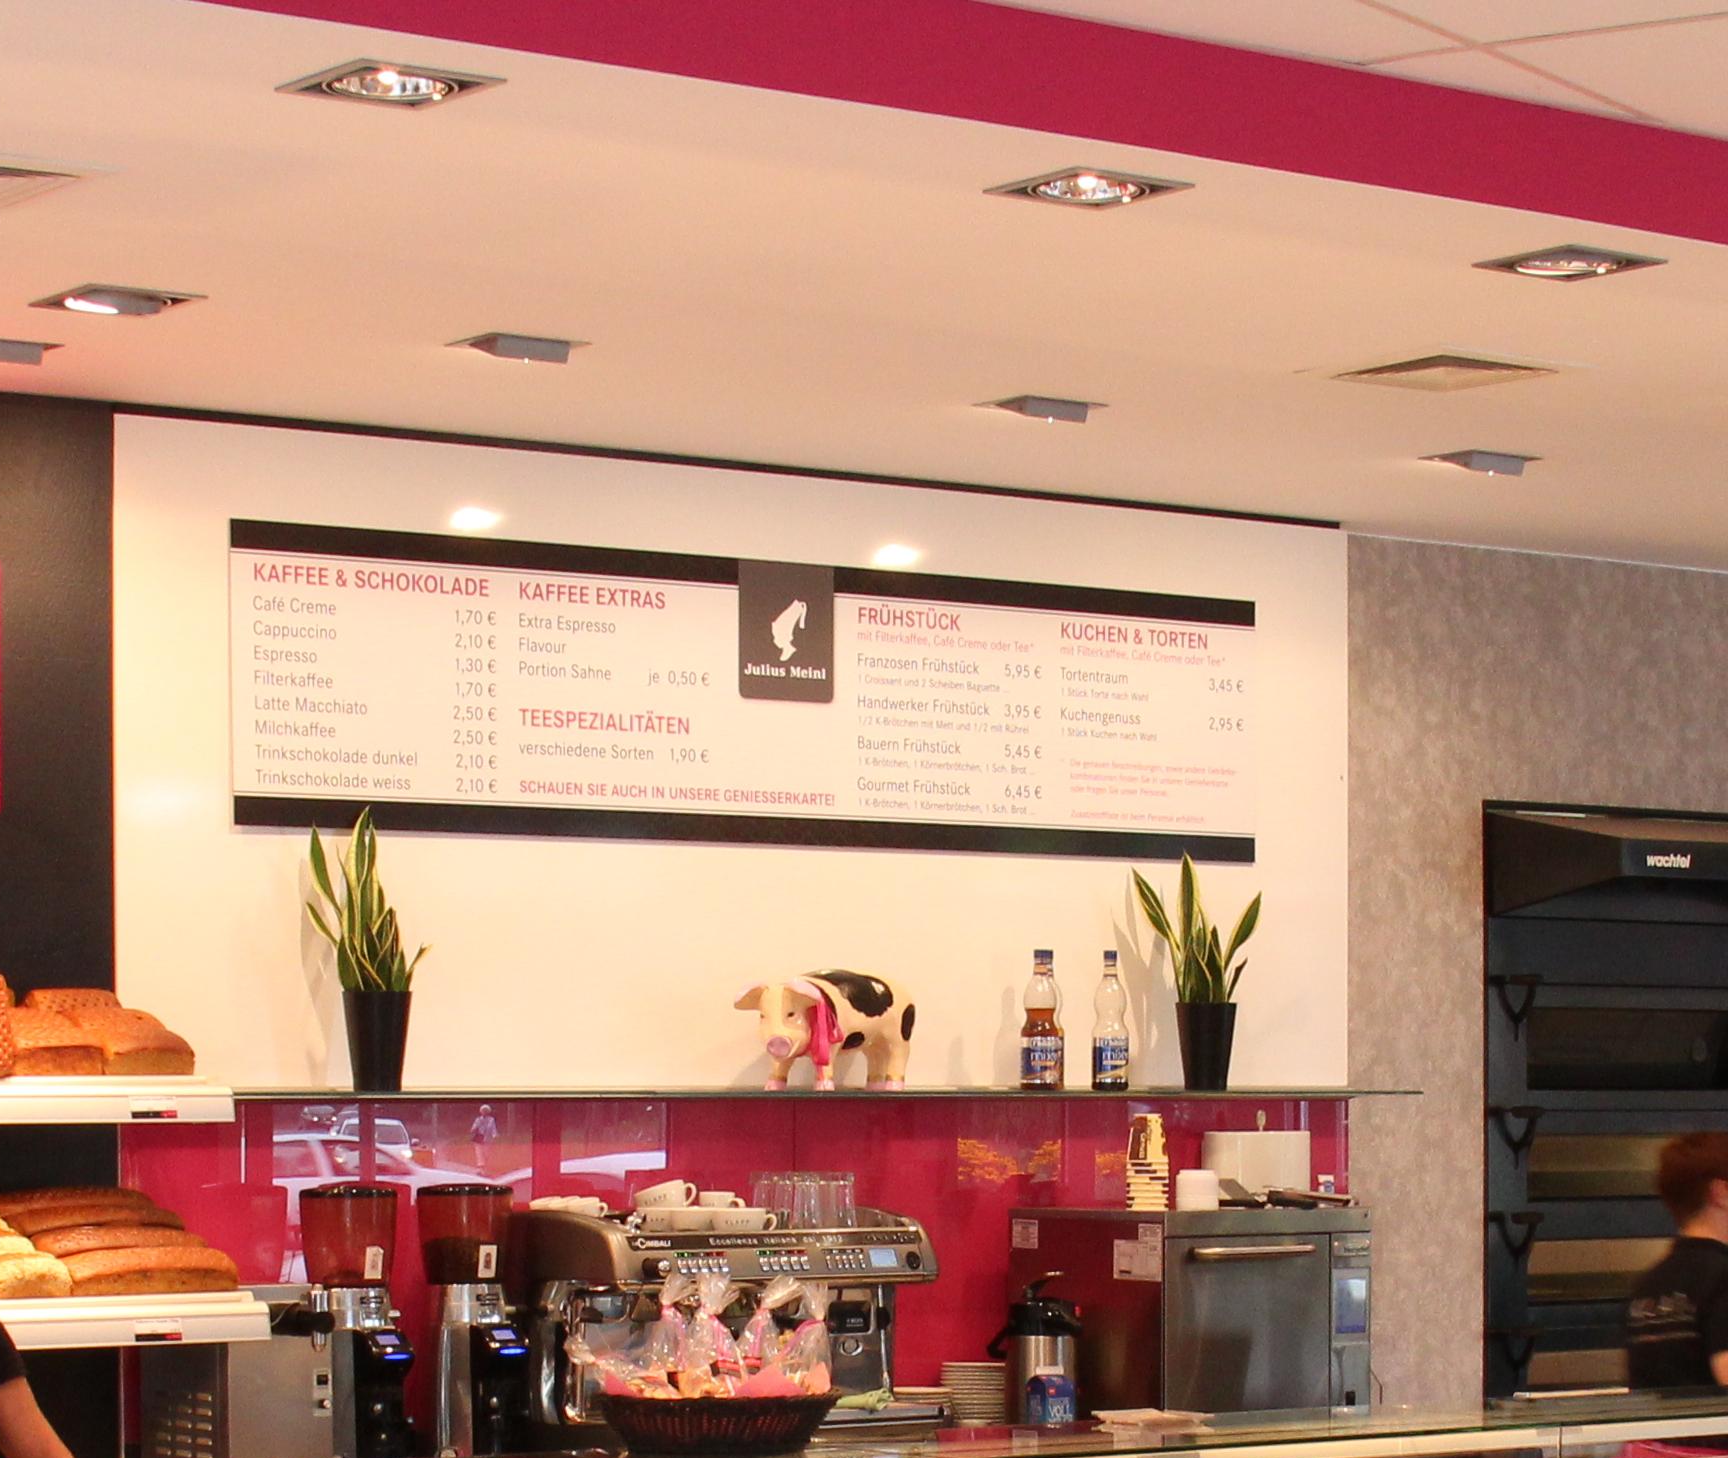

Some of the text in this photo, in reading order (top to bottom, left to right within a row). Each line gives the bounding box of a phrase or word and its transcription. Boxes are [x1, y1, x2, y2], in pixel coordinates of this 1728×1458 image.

[253, 562, 490, 597] KAFFEE & SCHOKOLADE
[519, 582, 665, 609] KAFFEE EXTRAS
[253, 595, 496, 626] Café Creme 1,70 €
[519, 613, 616, 634] Extra Espresso
[858, 604, 961, 631] FRÜHSTÜCK
[253, 620, 496, 650] Cappuccino 2,10 €
[519, 637, 567, 654] Flavour
[857, 631, 872, 642] mit
[958, 637, 987, 650] Creme
[991, 640, 1011, 651] oder
[1061, 622, 1208, 649] KUCHEN & TORTEN
[254, 645, 496, 674] Espresso 1,30 €
[744, 663, 826, 679] Julius Meinl
[858, 653, 1042, 679] Franzosen Frühstück 5,95 €
[254, 670, 496, 698] Filterkaffee 1,70 €
[519, 661, 710, 687] Portion Sahne je 0,50 €
[1061, 667, 1243, 694] Tortentraum 3,45 €
[255, 696, 496, 722] Latte Macchiato 2,50 €
[858, 696, 1041, 719] Handwerker Frühstück 3,95 €
[1061, 707, 1243, 733] Kuchengenuss 2,95 €
[255, 720, 497, 746] Milchkaffee 2,50 €
[519, 708, 690, 735] TEESPEZIALITÄTEN
[256, 744, 497, 770] Trinkschokolade dunkel 2,10 €
[519, 742, 709, 764] verschiedene Sorten 1,90 €
[858, 735, 1042, 759] Bauern Frühstück 5,45 €
[256, 769, 497, 794] Trinkschokolade weiss 2,10 €
[520, 780, 835, 807] SCHAUEN SIE AUCH IN UNSERE GENIESSERKARTE!
[858, 776, 1042, 800] Gourmet Frühstück 6,45 €
[1646, 853, 1691, 868] wachtel
